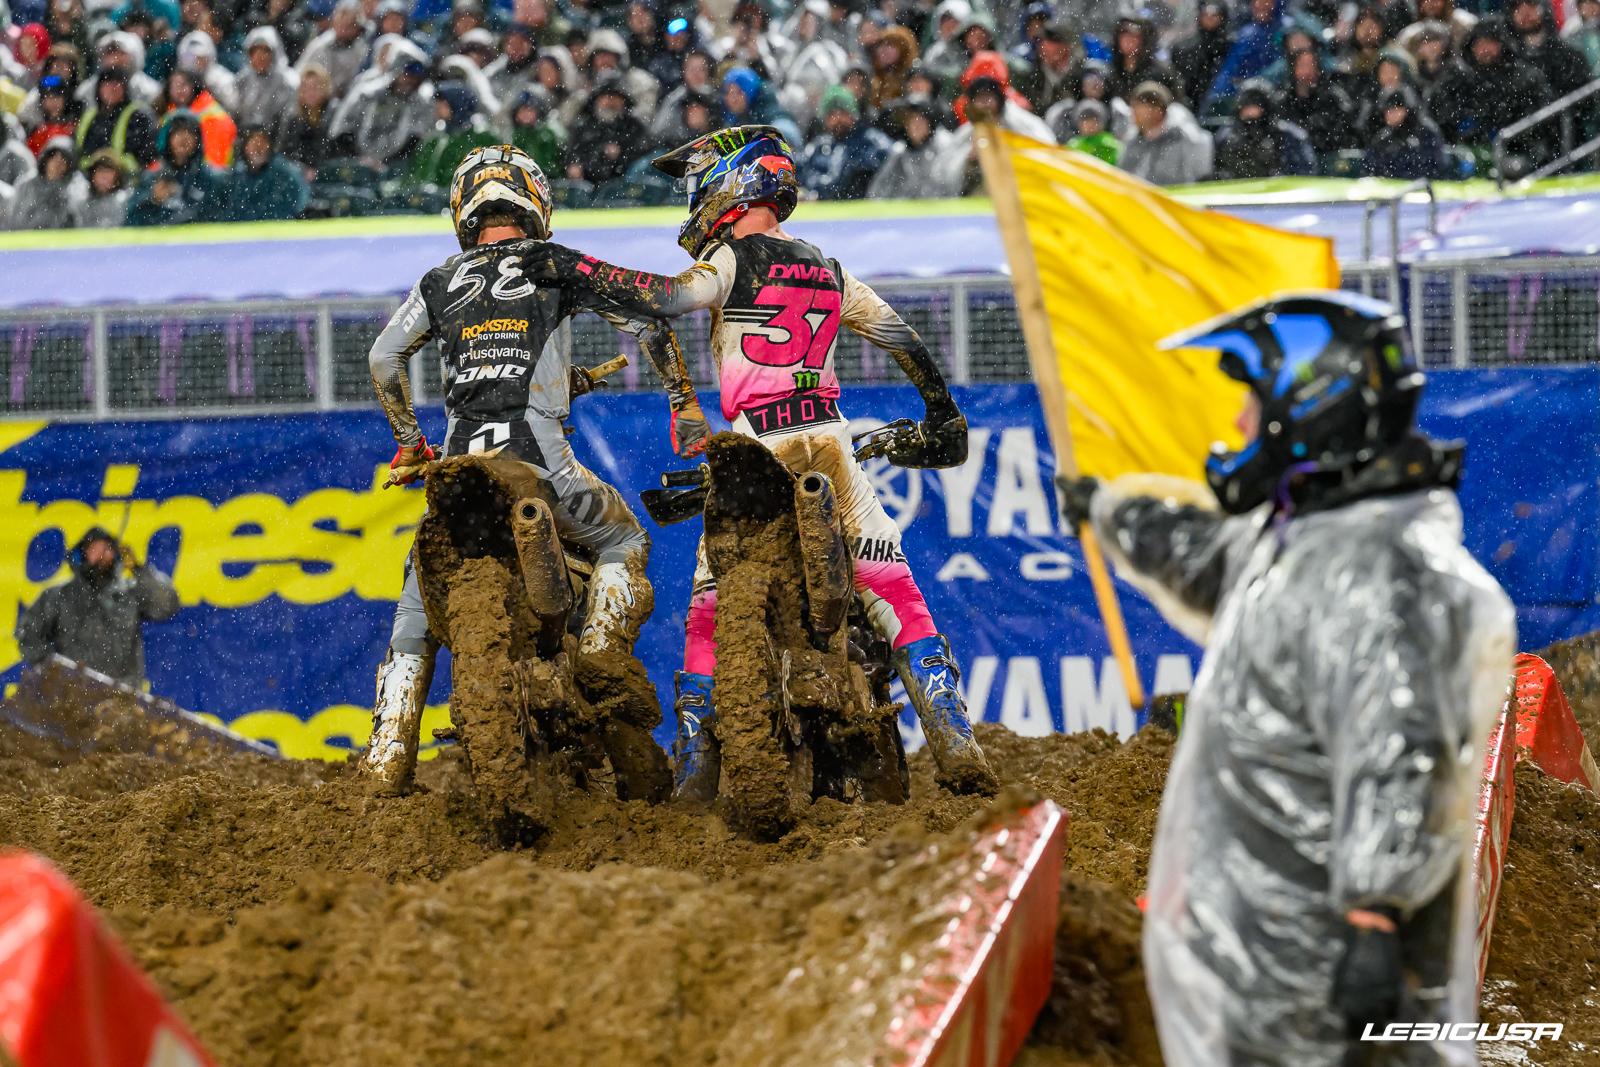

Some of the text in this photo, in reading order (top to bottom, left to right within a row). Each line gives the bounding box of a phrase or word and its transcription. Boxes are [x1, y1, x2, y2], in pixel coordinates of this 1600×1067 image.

[473, 166, 514, 187] DAX
[461, 318, 529, 341] ROCKSTAR
[495, 332, 521, 340] DRINK
[740, 284, 843, 370] 37
